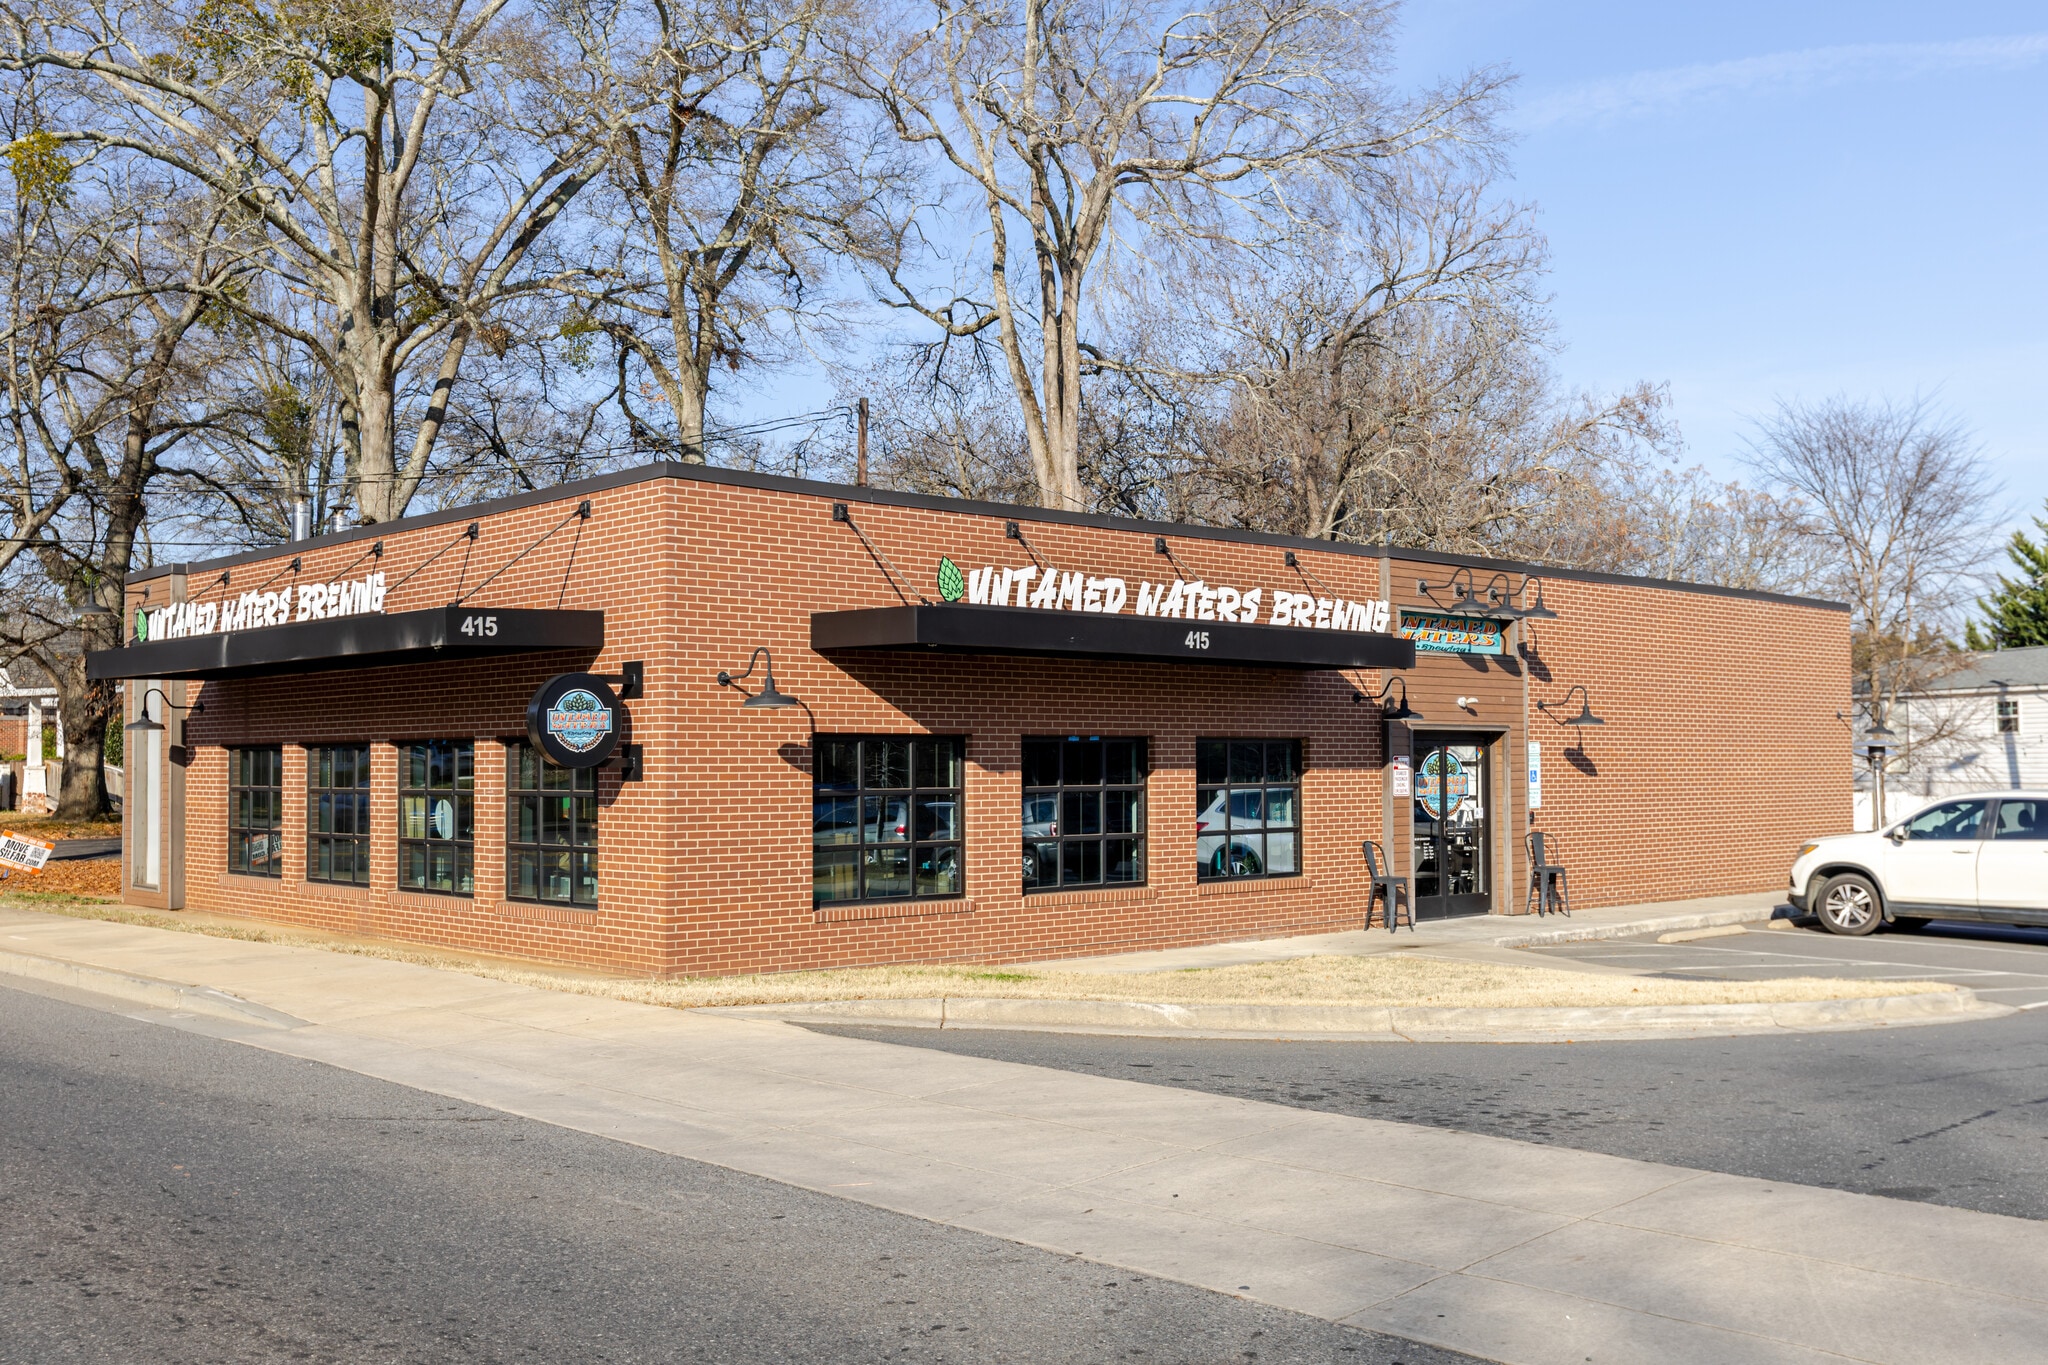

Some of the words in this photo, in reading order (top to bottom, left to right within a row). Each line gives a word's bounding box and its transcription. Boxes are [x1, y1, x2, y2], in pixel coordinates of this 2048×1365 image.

[149, 601, 218, 642] UNTAMED
[220, 585, 293, 633] WATERS
[296, 571, 387, 623] BREWING
[968, 565, 1127, 614] UNTAMED
[1135, 579, 1263, 624] WATERS
[1269, 590, 1391, 634] BREWING
[460, 616, 498, 637] 415
[1184, 630, 1210, 650] 415
[552, 711, 609, 723] UNTAMED
[552, 720, 607, 730] WATERS
[4, 839, 30, 855] MOVE
